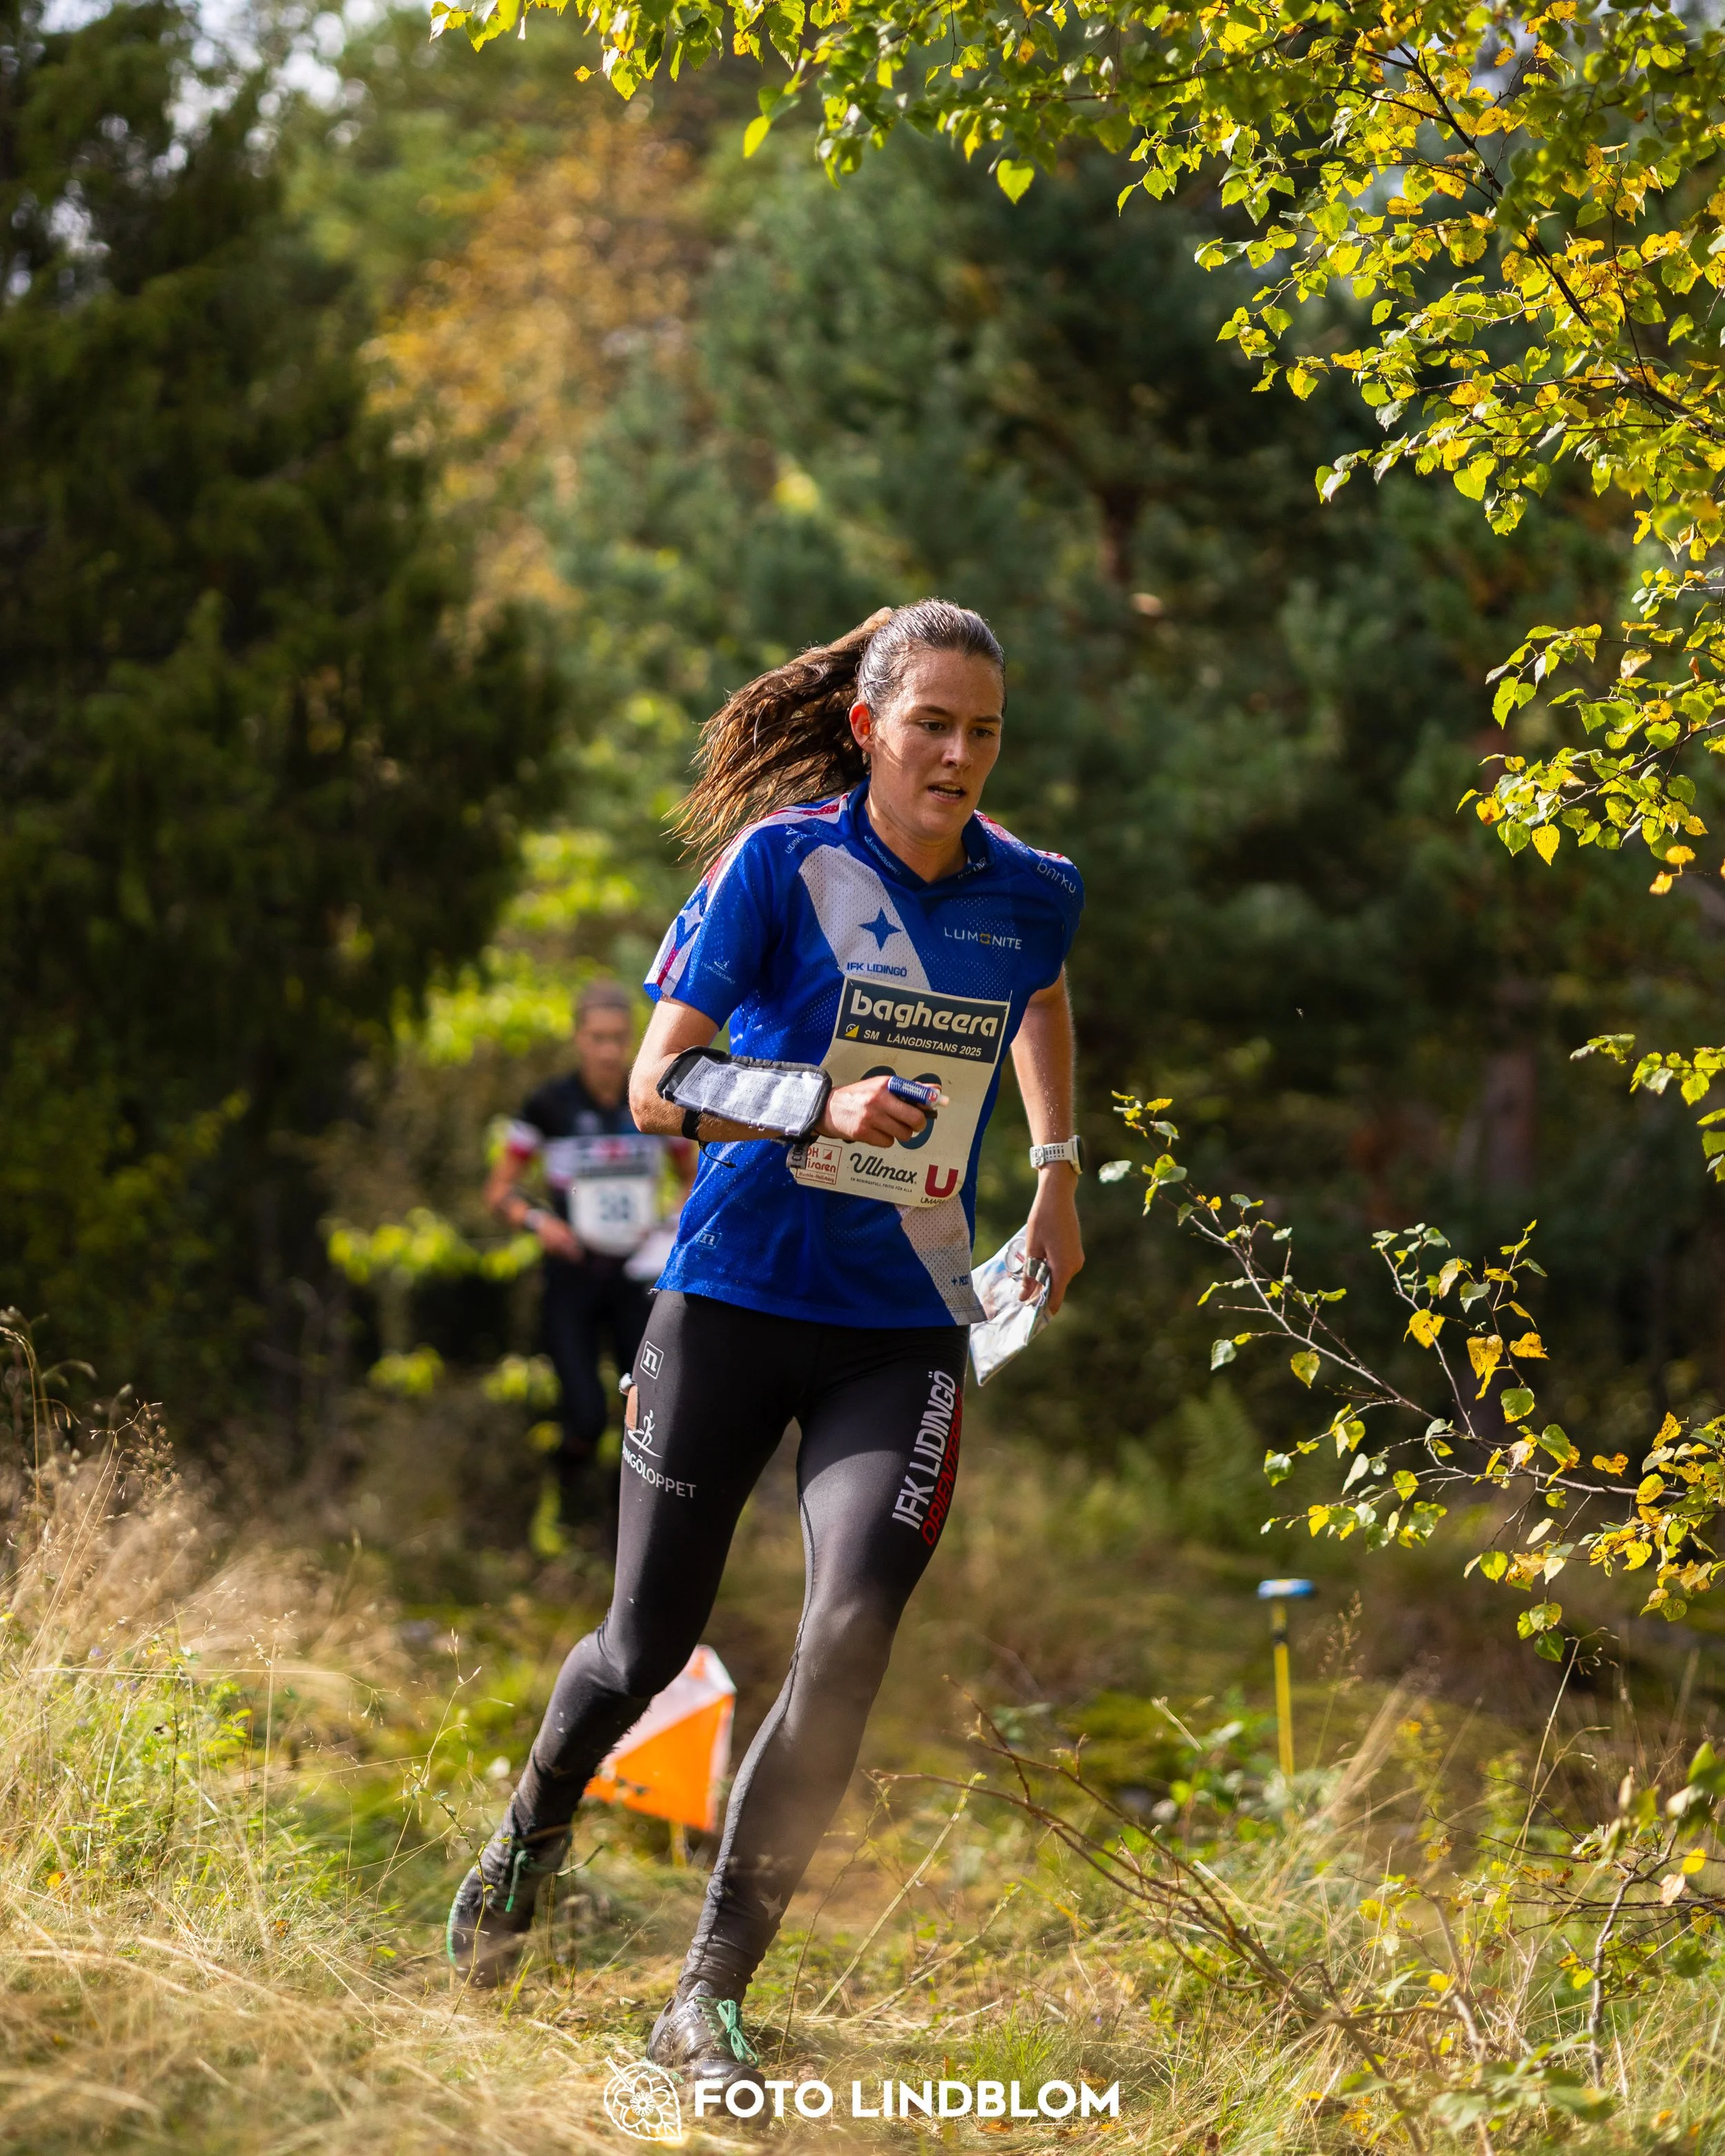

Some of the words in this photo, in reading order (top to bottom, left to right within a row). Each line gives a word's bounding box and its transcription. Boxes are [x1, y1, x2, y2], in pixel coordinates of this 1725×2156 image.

[944, 927, 1023, 949] LUMONITE
[847, 962, 864, 971] IFK
[867, 965, 907, 977] LIDINGÖ
[850, 989, 998, 1037] bagheera
[864, 1029, 880, 1040] SM
[887, 1031, 958, 1052] LÅNGDISTANS
[959, 1046, 982, 1057] 2025
[807, 1158, 836, 1173] isaren
[850, 1153, 918, 1184] Ullmax
[909, 1369, 956, 1478] LIDINGÖ
[891, 1474, 934, 1530] IFK
